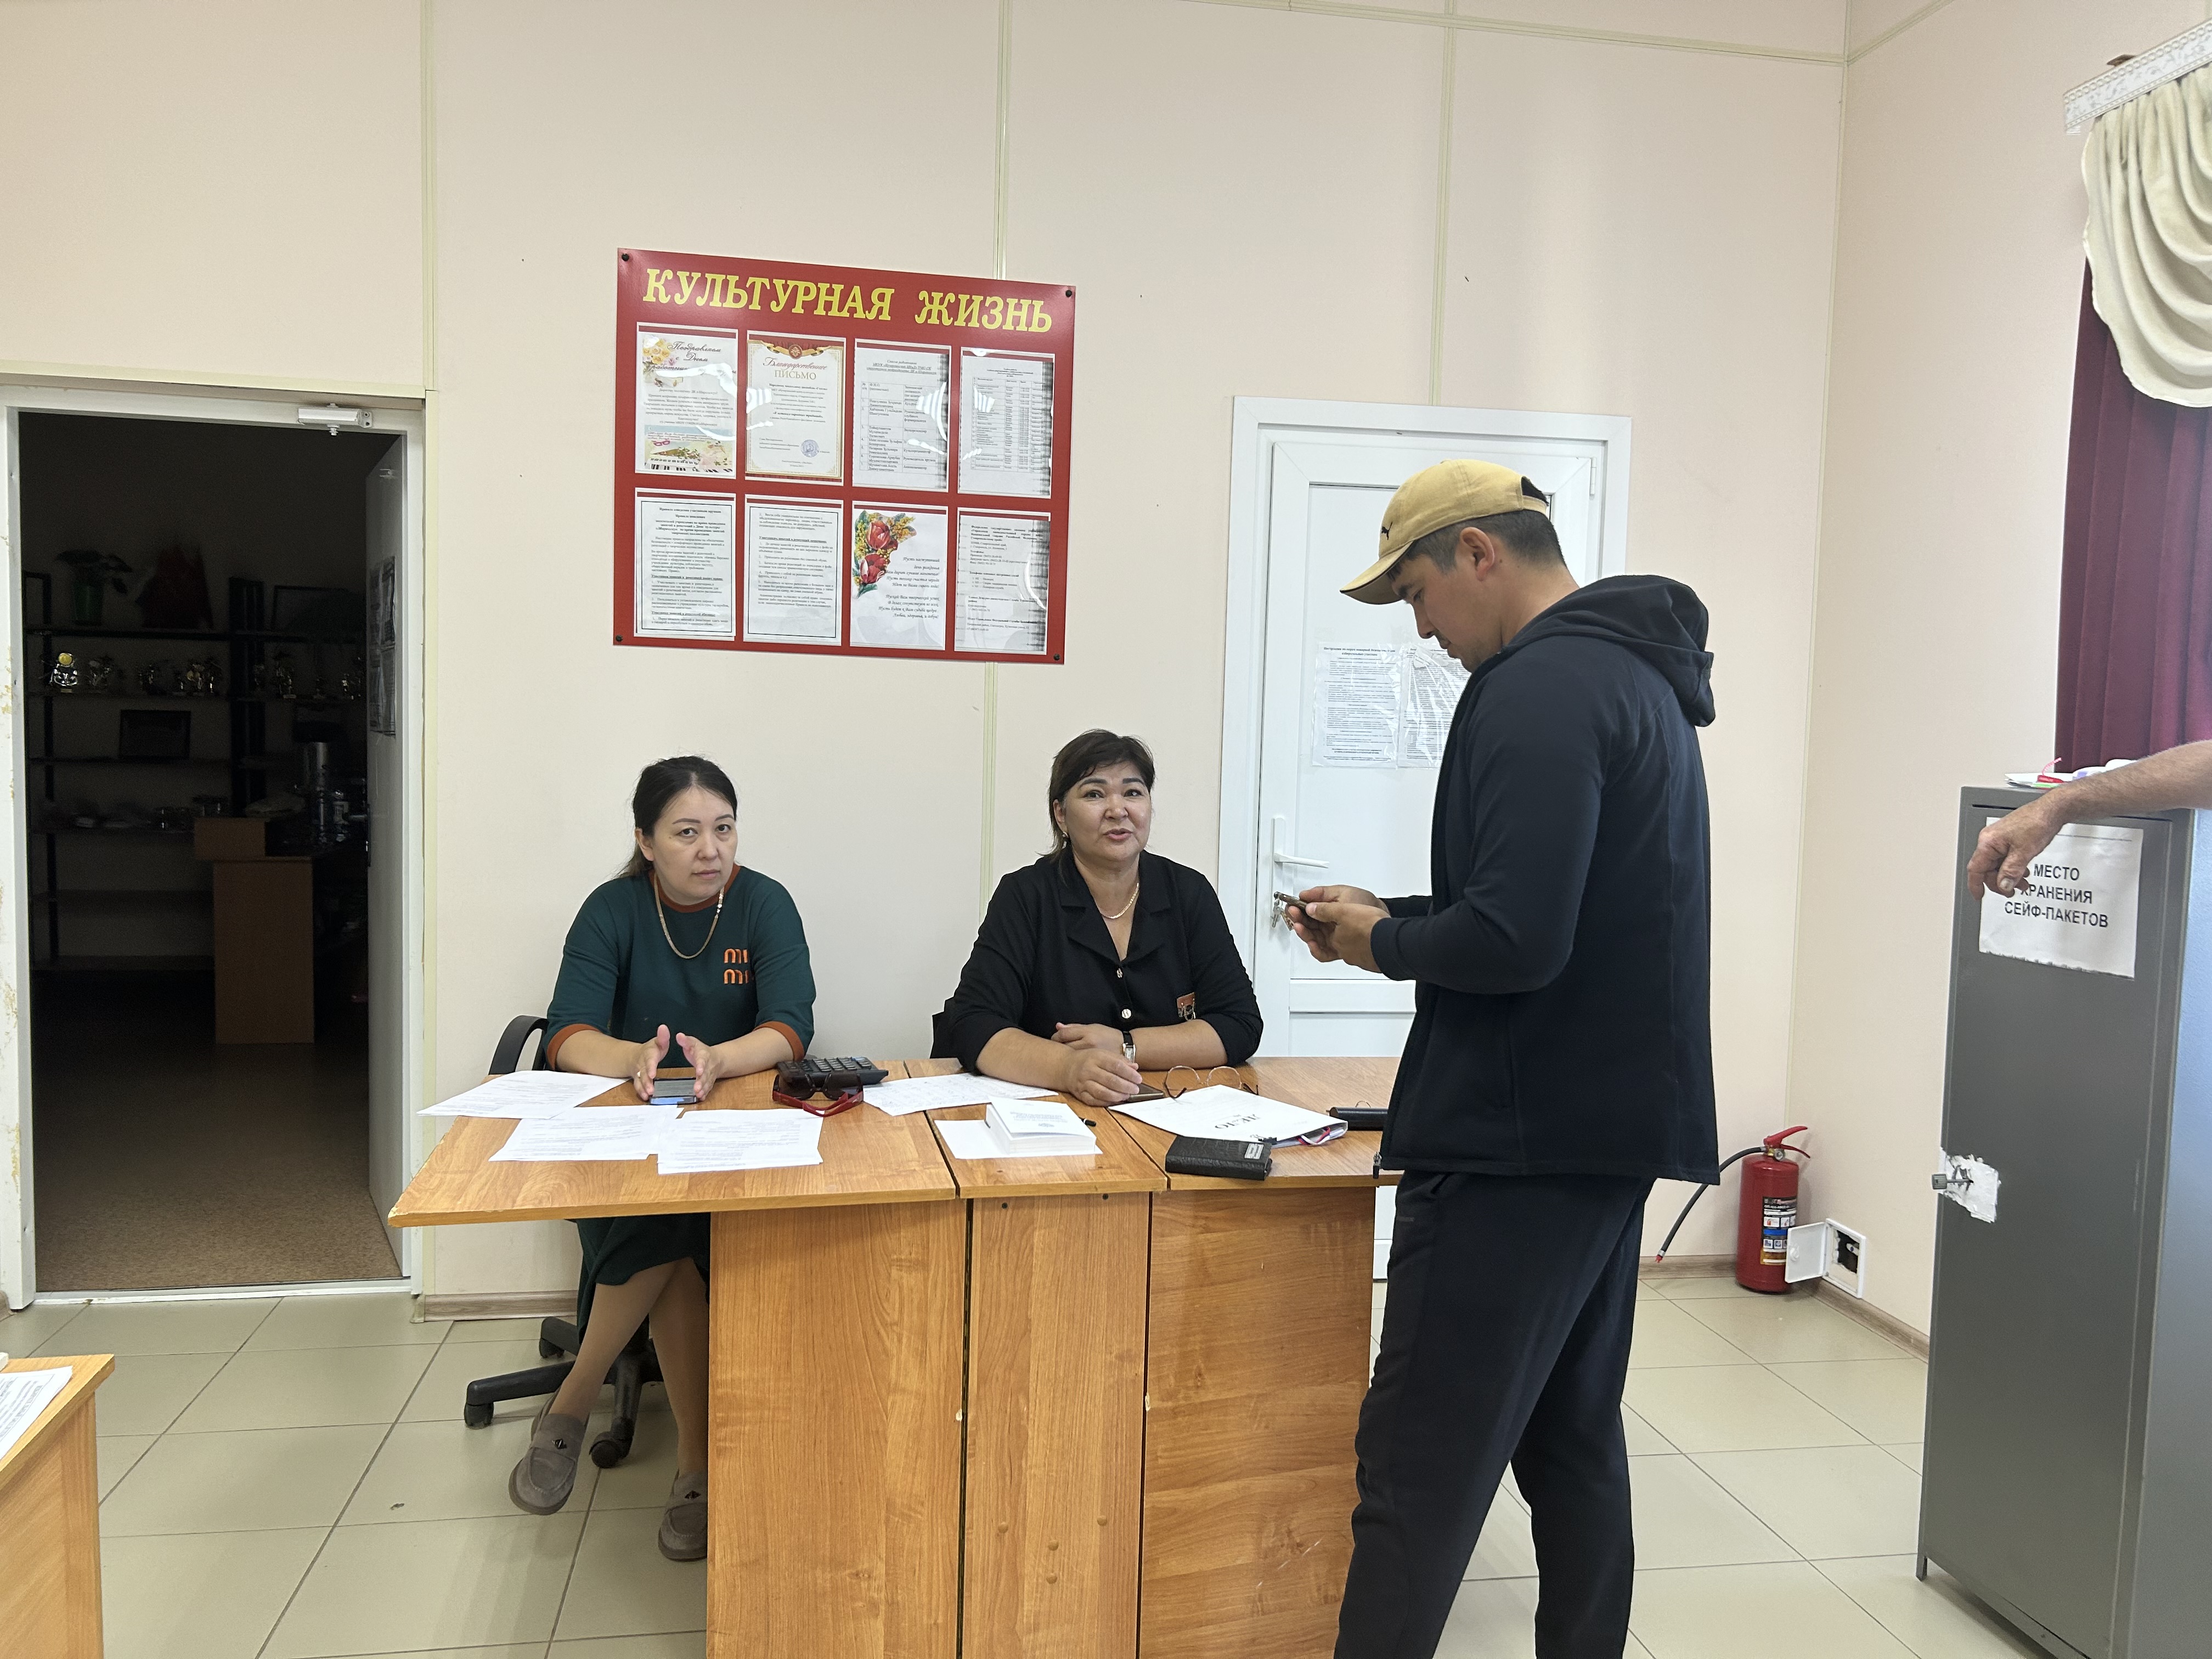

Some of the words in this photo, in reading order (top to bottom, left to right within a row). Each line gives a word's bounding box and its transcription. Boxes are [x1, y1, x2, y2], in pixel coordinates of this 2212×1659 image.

[642, 268, 895, 321] КУЛЬТУРНАЯ
[915, 290, 1052, 332] ЖИЗНЬ
[667, 341, 721, 354] Поздравляем
[775, 369, 816, 380] ПИСЬМО
[2033, 864, 2080, 881] МЕСТО
[2005, 901, 2108, 928] СЕЙФ-ПАКЕТОВ
